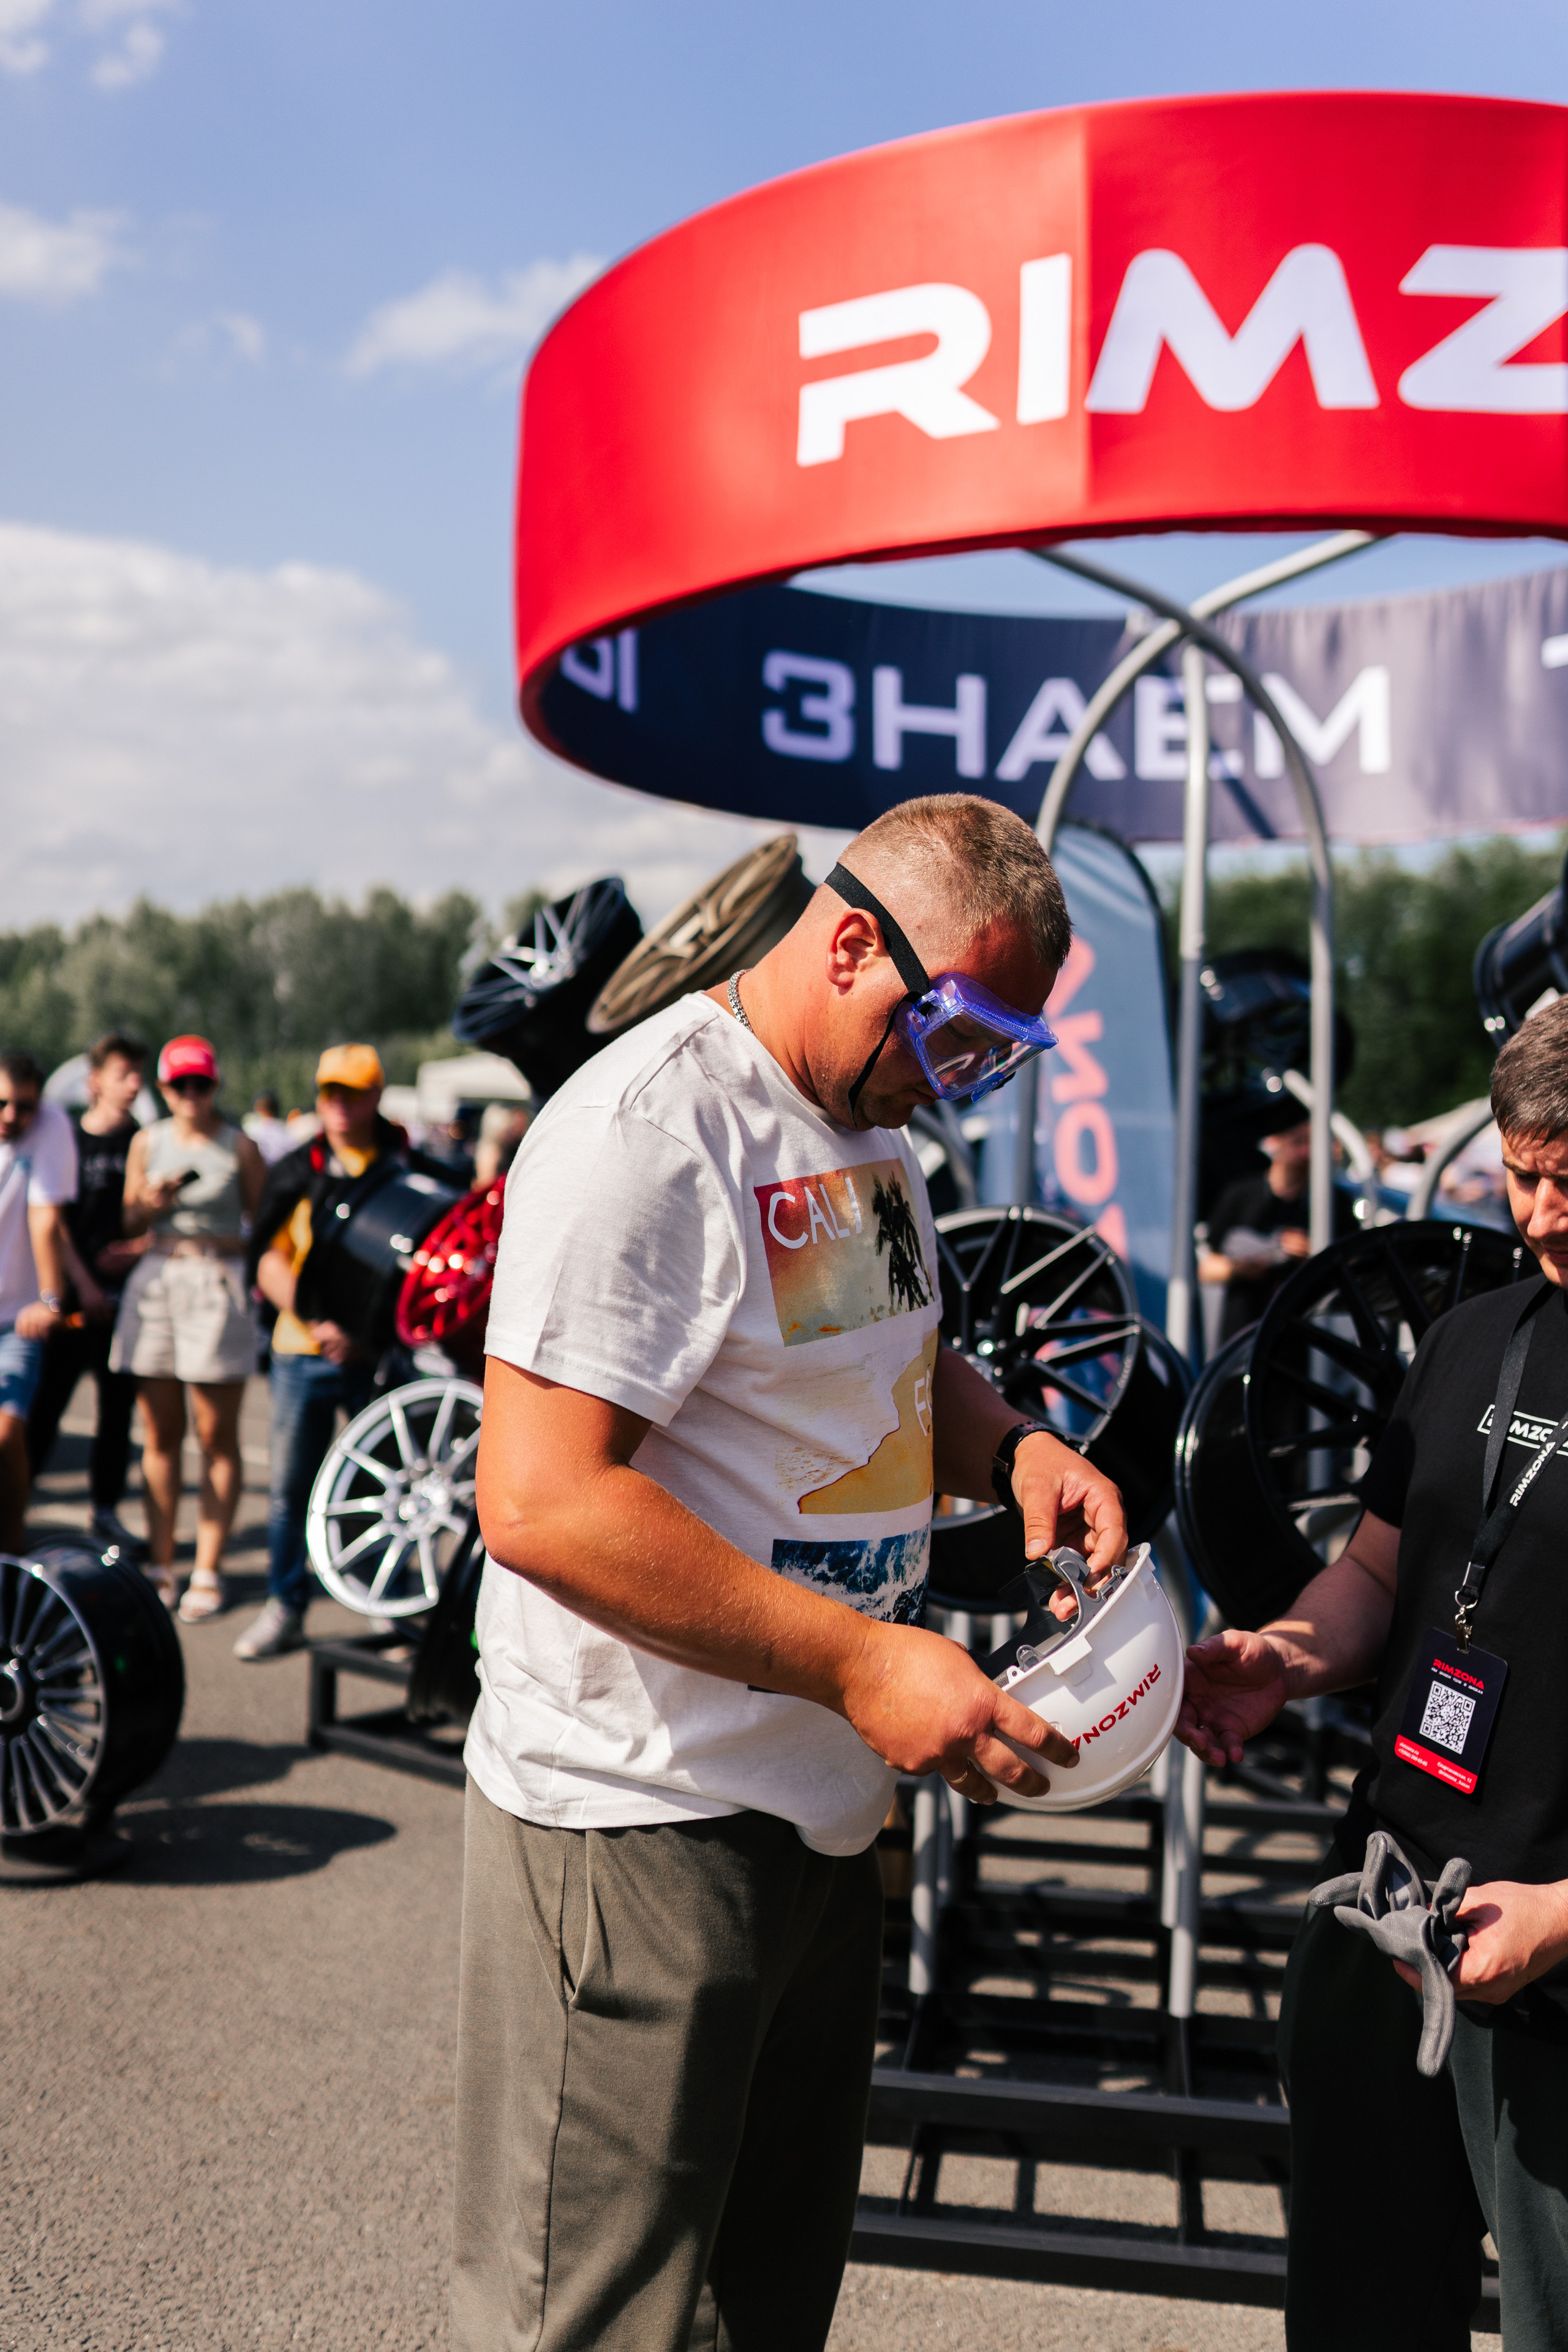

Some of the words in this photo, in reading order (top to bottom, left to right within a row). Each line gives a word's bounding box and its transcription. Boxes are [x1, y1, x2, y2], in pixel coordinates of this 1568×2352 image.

[762, 649, 1389, 781] ЗНАЕМ
[767, 1177, 862, 1250] CALI
[1509, 1441, 1556, 1507] RIMZONA
[1433, 1659, 1485, 1689] RIMZONA
